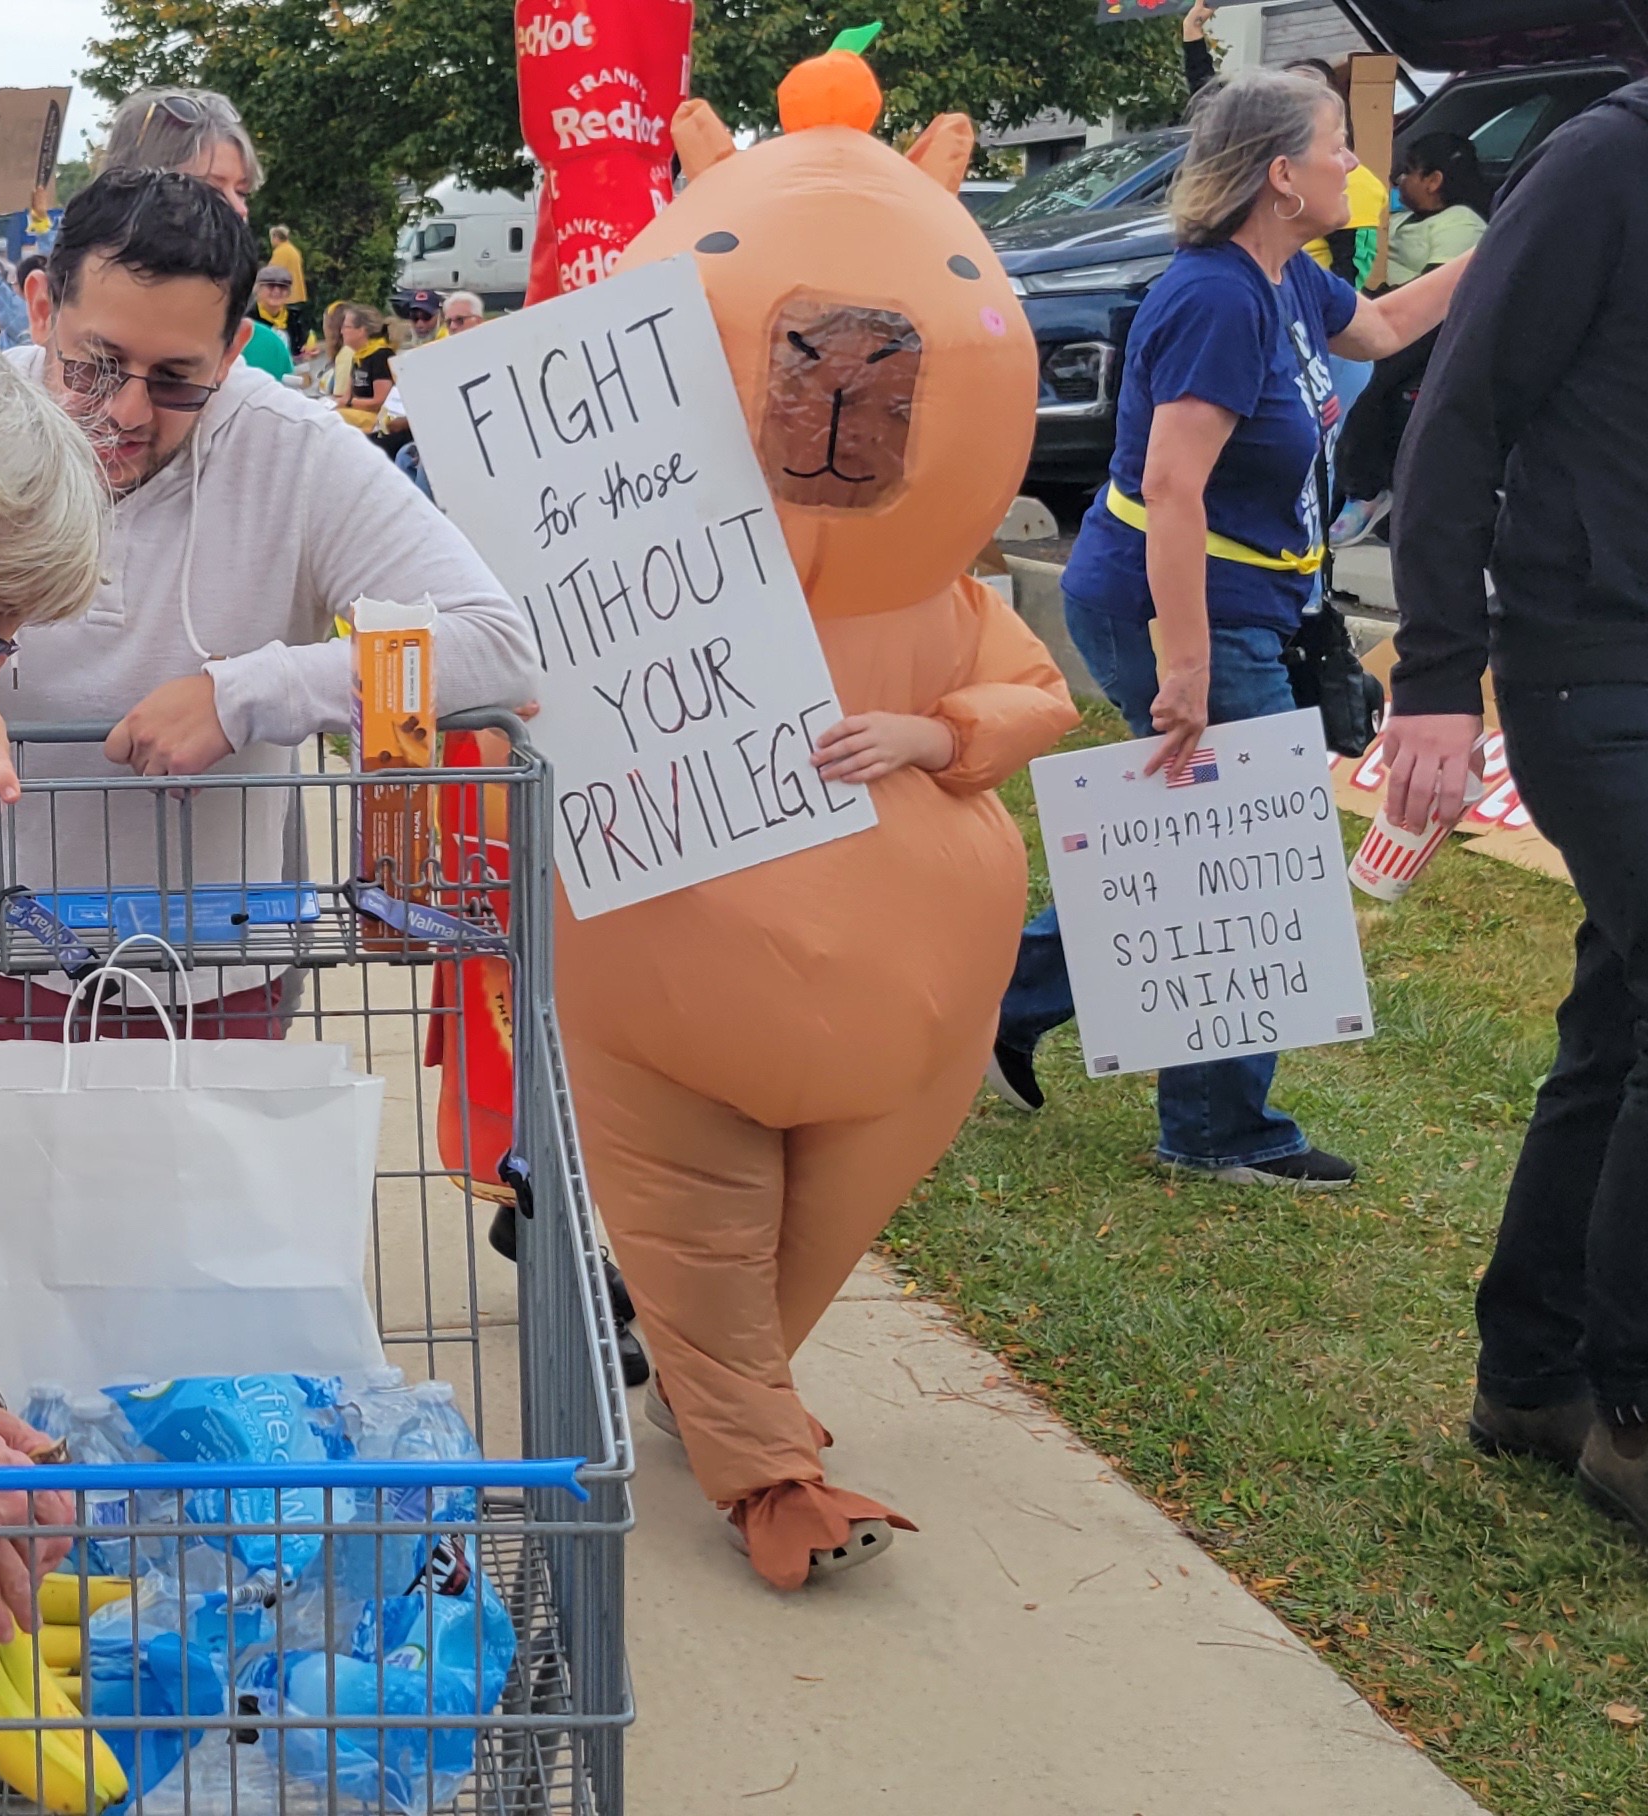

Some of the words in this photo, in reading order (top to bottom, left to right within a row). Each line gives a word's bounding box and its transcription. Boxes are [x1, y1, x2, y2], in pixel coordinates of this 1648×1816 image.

[567, 66, 648, 102] FRANK'S
[551, 100, 665, 150] RedHot
[457, 306, 681, 479] FIGHT
[534, 485, 587, 550] for
[598, 452, 698, 520] those
[523, 507, 767, 673] ITHOUT
[593, 636, 757, 754] YOUR
[558, 699, 857, 890] PRIVILEGE
[1100, 785, 1330, 856] Constitution!
[1101, 870, 1158, 906] the
[1198, 844, 1326, 897] FOLLOW
[1112, 907, 1302, 968] POLITICS
[1140, 960, 1309, 1013] PLAYING
[1186, 1010, 1278, 1051] STOP
